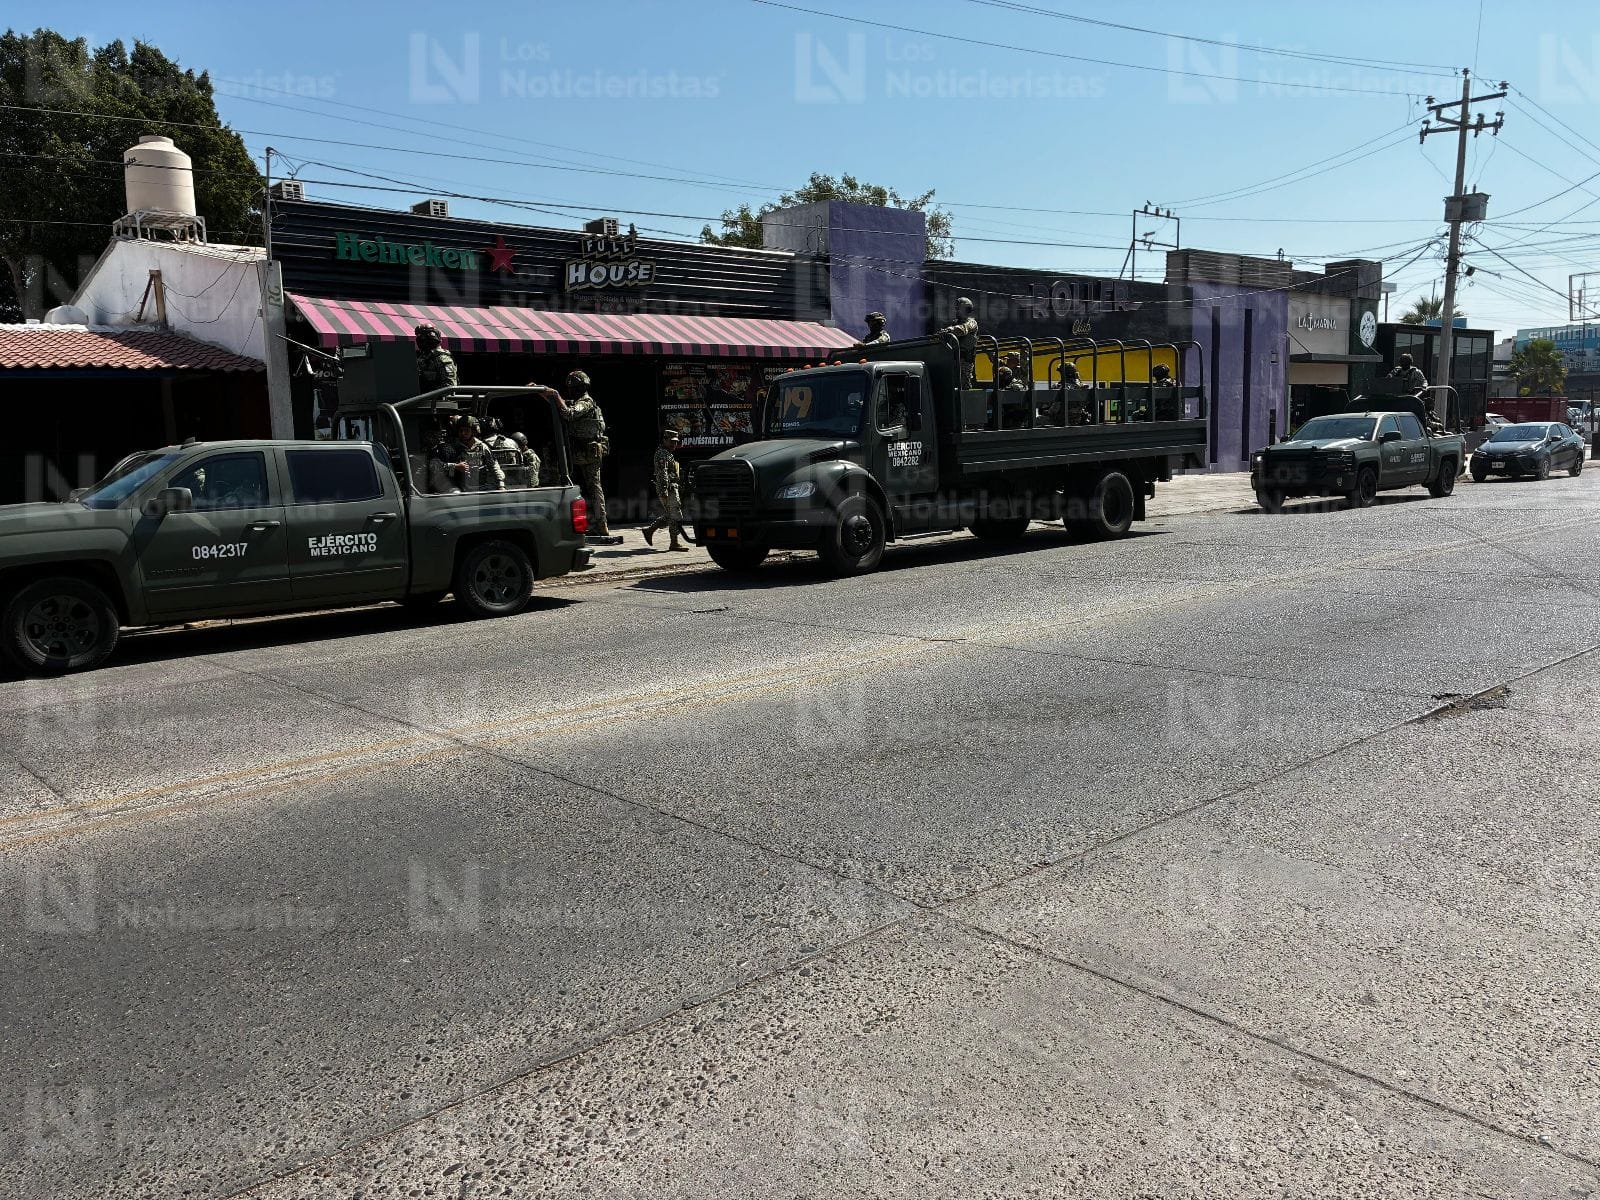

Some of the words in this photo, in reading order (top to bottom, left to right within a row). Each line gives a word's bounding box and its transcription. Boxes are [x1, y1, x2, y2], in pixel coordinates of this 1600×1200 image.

[336, 231, 478, 270] Heineken
[586, 239, 630, 253] FULL
[568, 261, 651, 284] HOUSE
[1031, 280, 1130, 318] ROLLER
[888, 449, 922, 458] MEXICANO
[308, 533, 377, 549] EJÉRCITO
[192, 542, 248, 560] 0842317
[310, 544, 377, 557] MEXICANO
